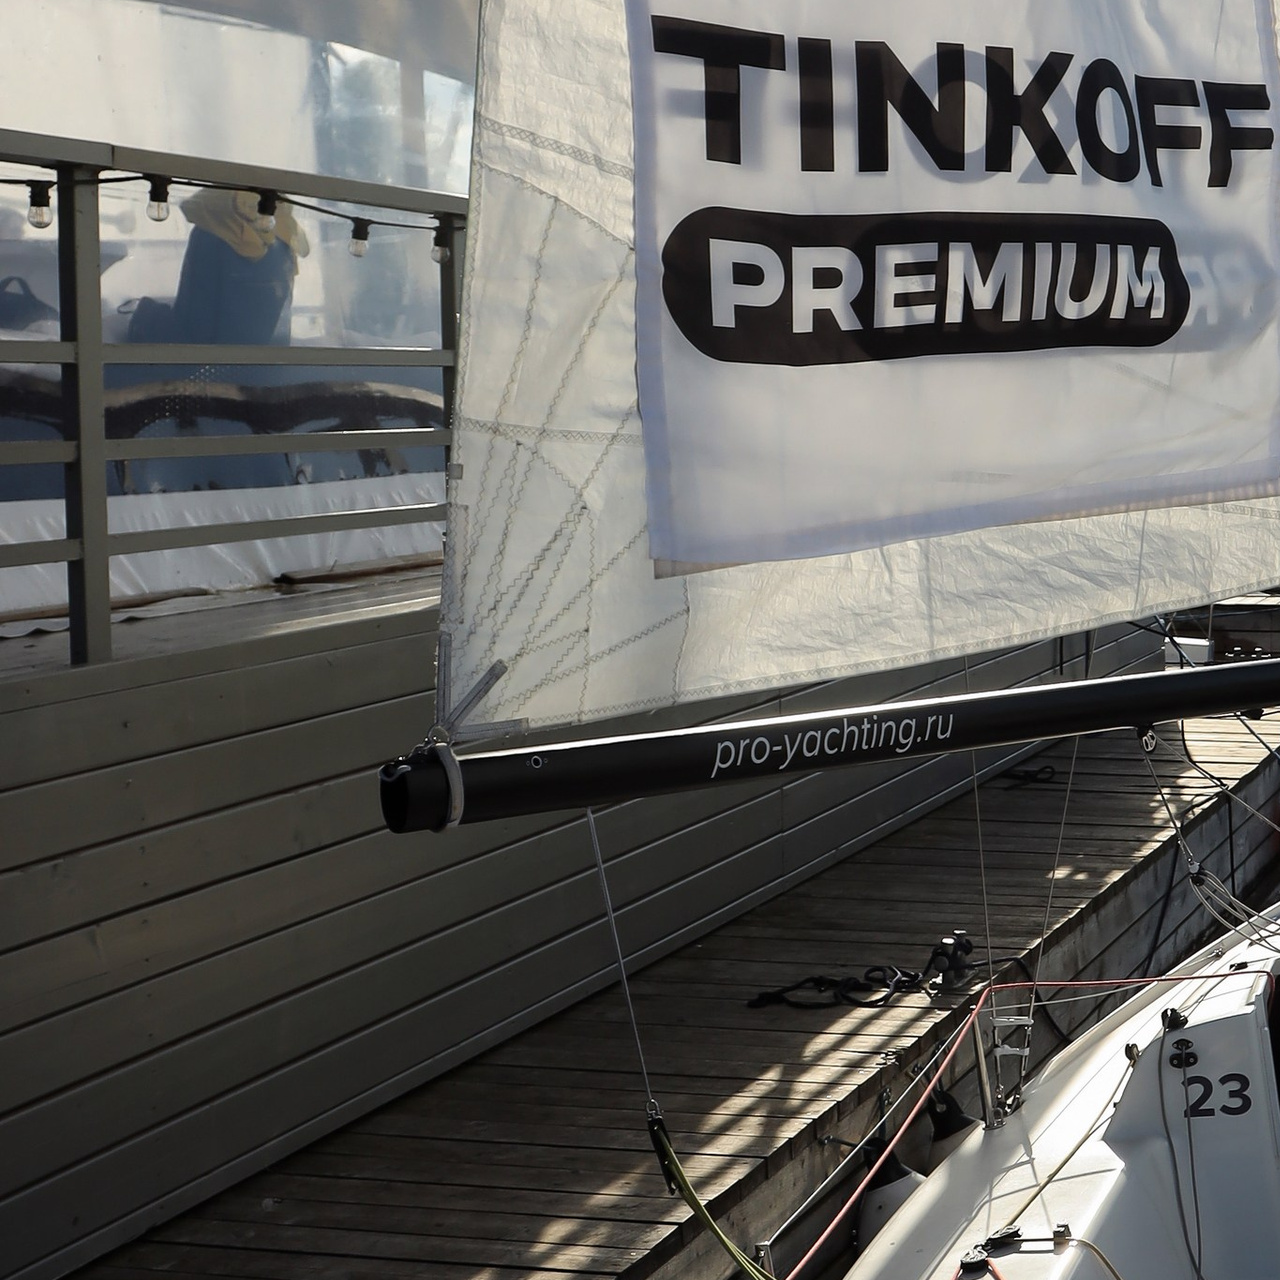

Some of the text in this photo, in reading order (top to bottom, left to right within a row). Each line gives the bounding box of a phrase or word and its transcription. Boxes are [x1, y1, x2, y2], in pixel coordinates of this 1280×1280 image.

[651, 14, 1274, 189] TINKOFF
[709, 237, 1166, 334] PREMIUM
[710, 713, 954, 779] pro-yachting.ru
[1182, 1073, 1252, 1118] 23
